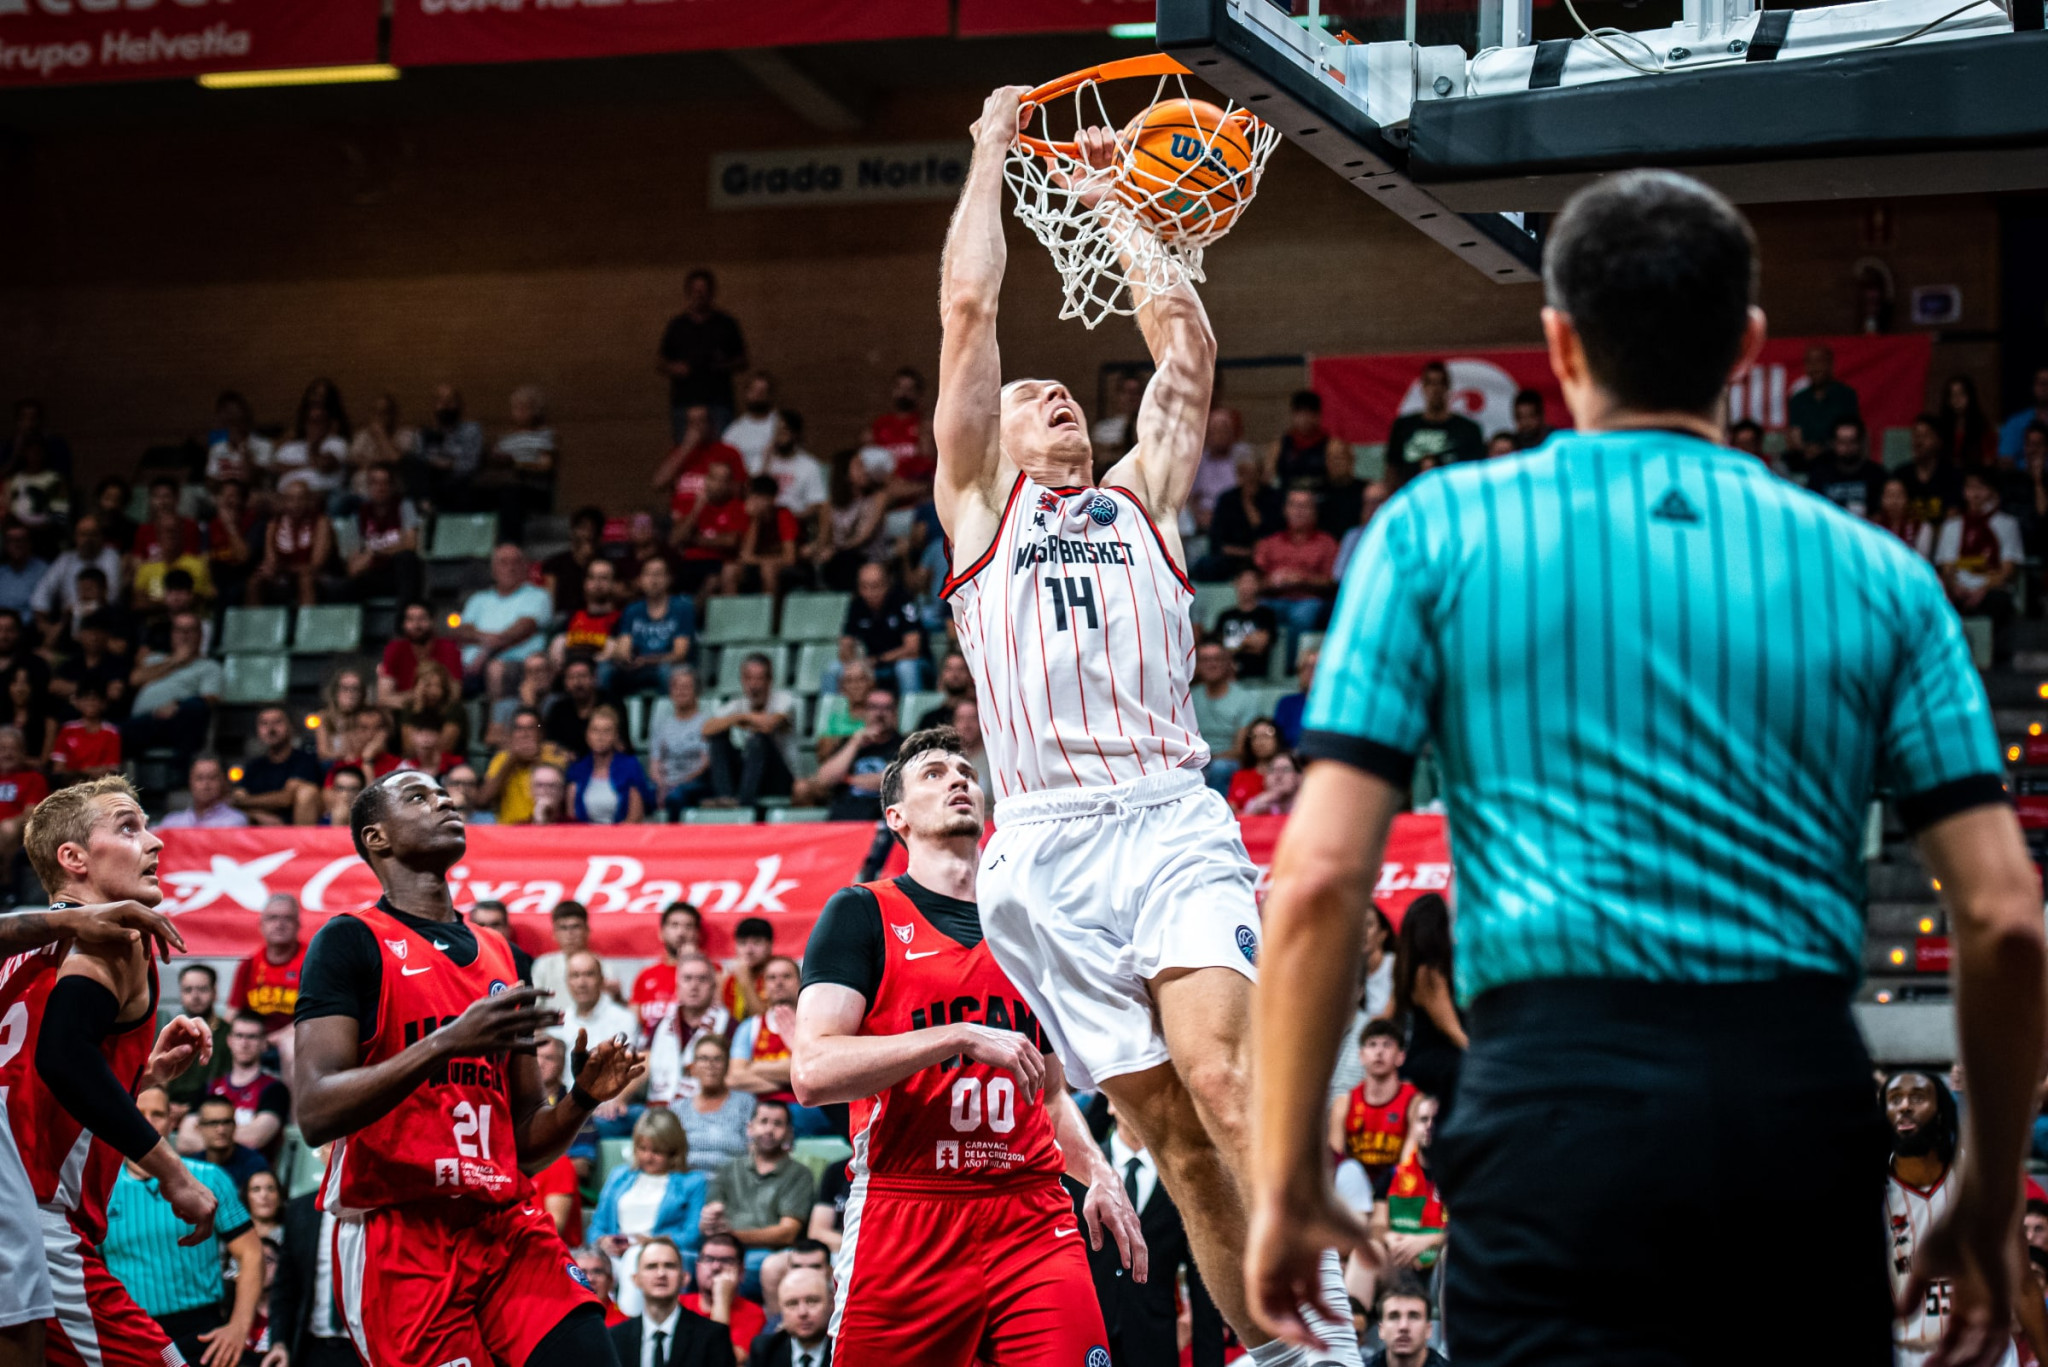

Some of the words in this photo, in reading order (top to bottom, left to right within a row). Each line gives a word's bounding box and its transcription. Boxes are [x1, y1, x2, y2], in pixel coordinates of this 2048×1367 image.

[0, 39, 92, 77] rupo
[722, 162, 844, 196] Grada
[857, 156, 964, 189] Norte
[1170, 132, 1247, 193] Wilson
[1044, 576, 1099, 631] 14
[300, 854, 799, 913] CixaBank
[452, 1100, 492, 1160] 21
[950, 1076, 1016, 1134] 00
[964, 1150, 976, 1159] DE
[976, 1151, 987, 1159] LA
[988, 1151, 1007, 1160] CRUZ
[964, 1159, 982, 1168] AÑO
